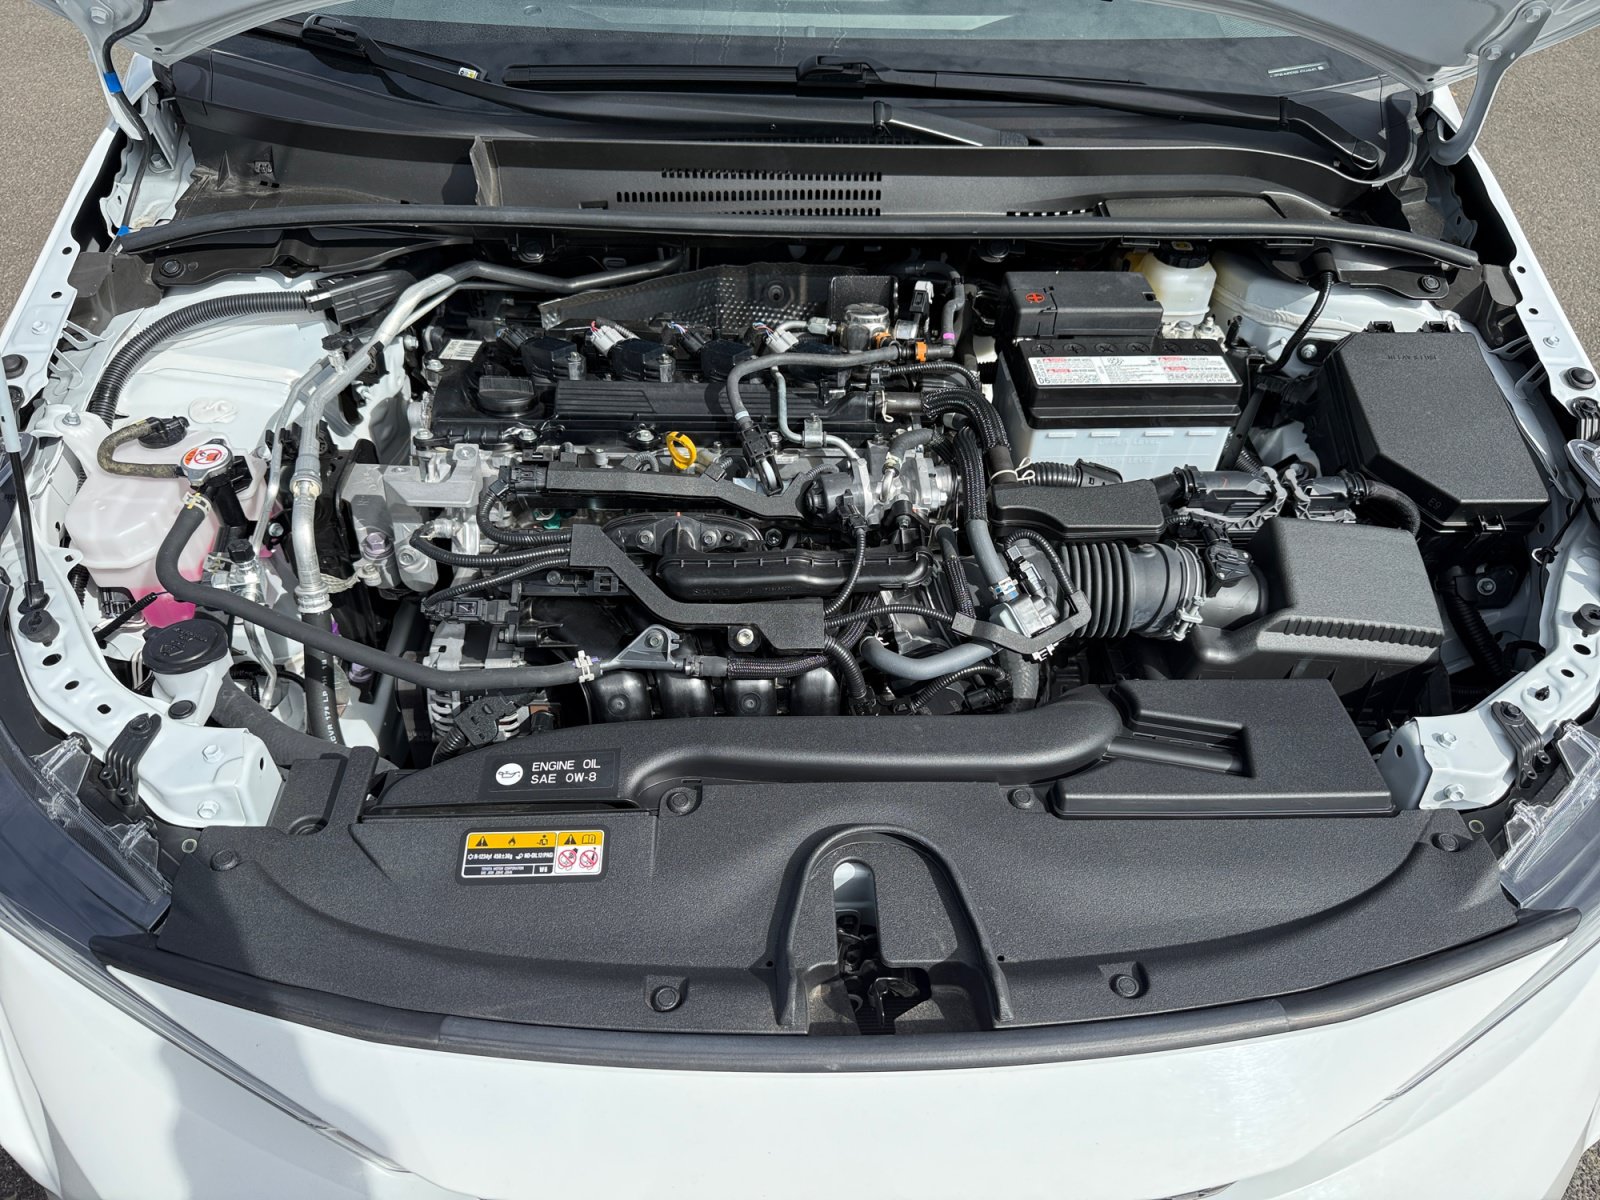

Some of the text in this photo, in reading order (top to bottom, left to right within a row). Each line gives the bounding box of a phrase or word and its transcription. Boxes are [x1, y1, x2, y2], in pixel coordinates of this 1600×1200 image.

[531, 759, 601, 772] ENGINE OIL
[530, 773, 557, 784] SAE
